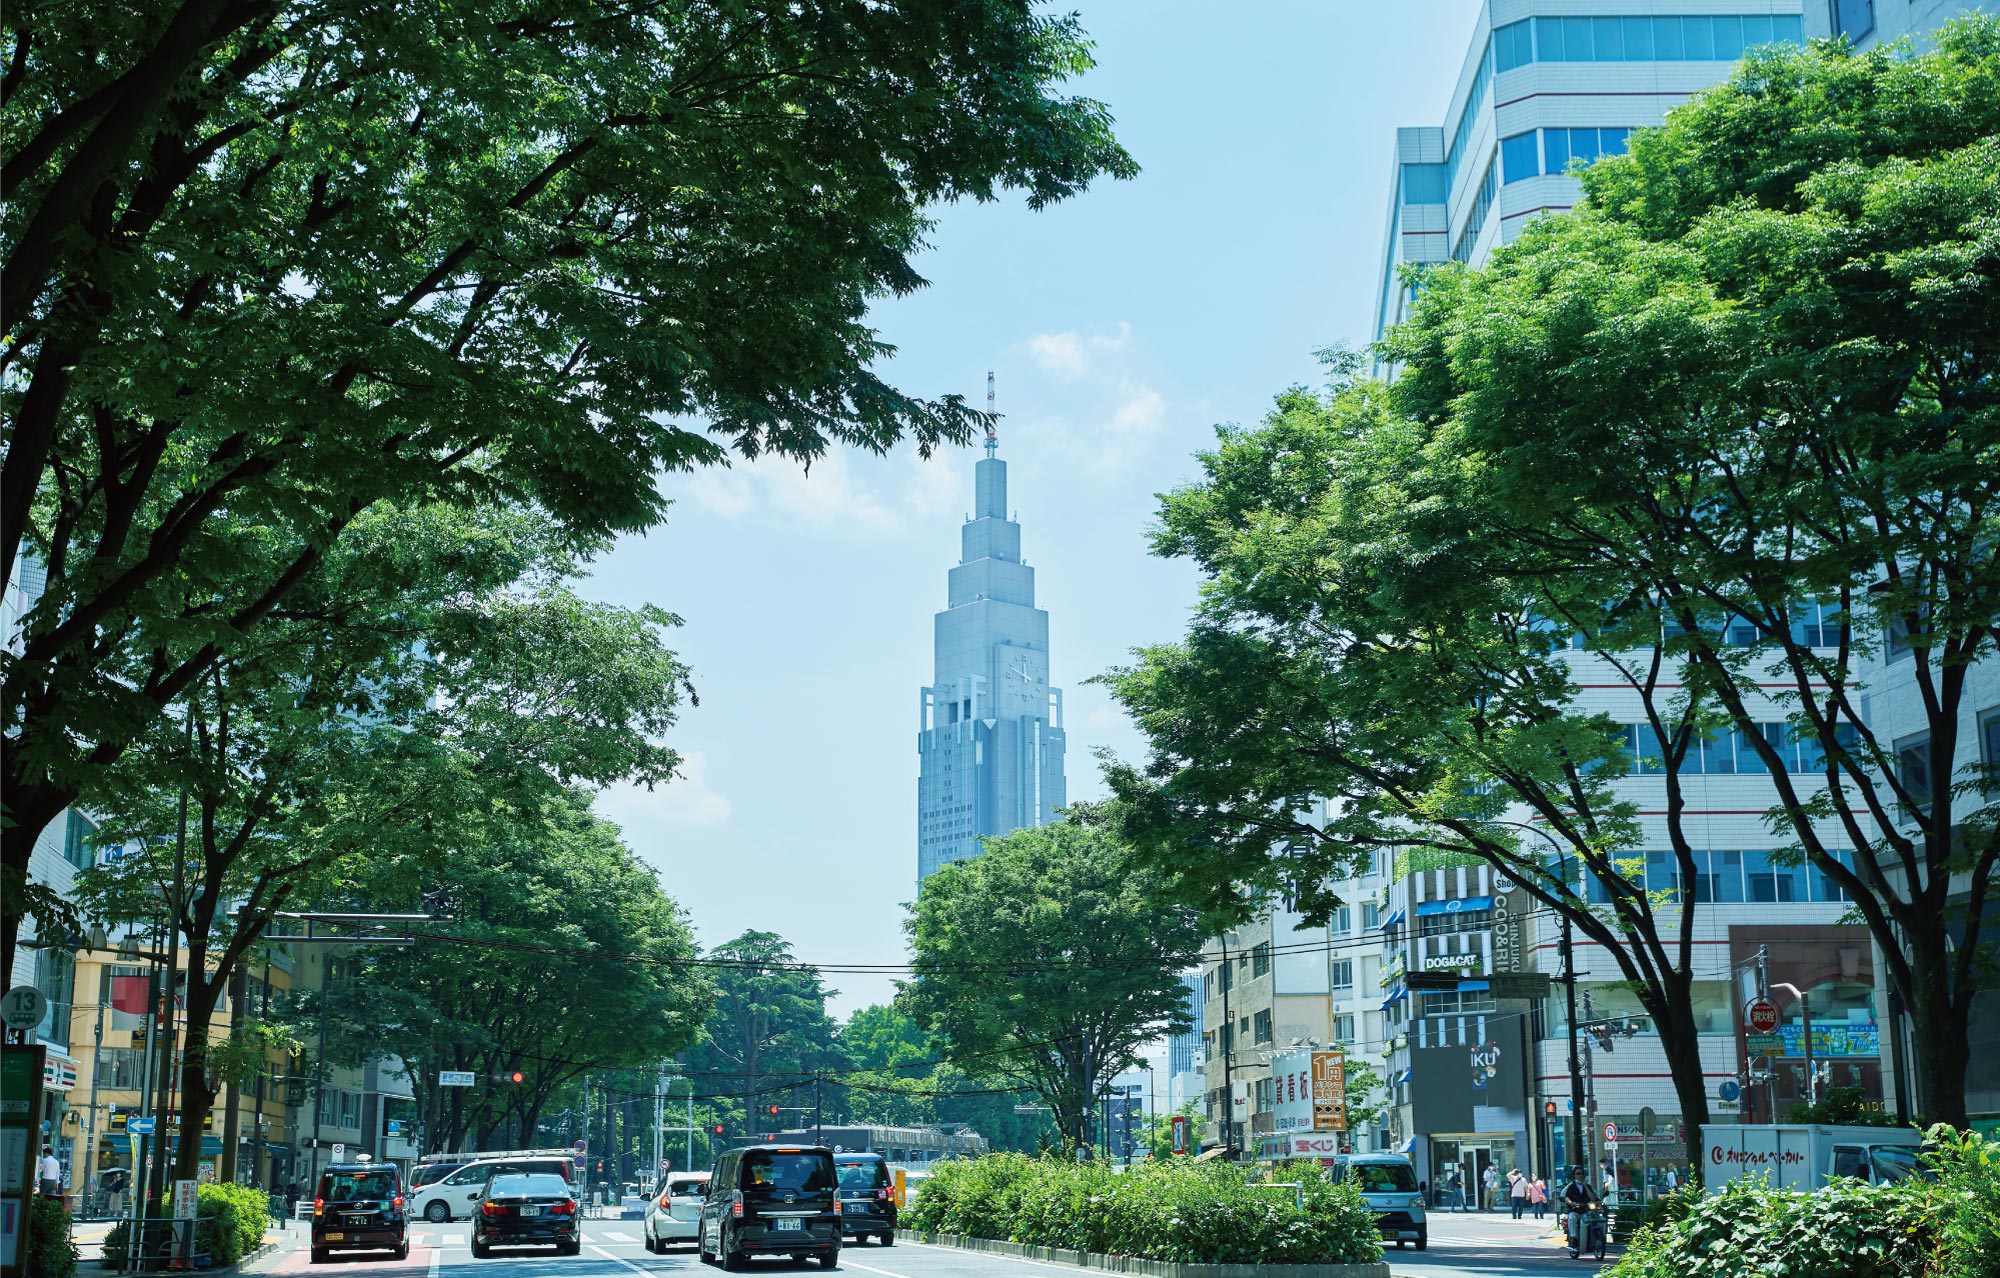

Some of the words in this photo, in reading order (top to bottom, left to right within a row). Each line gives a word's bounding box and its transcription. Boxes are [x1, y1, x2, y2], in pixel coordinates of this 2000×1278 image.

[1497, 879, 1515, 888] Shop
[1509, 912, 1520, 973] SHINJUKU
[1426, 954, 1477, 968] DOG&CAT
[13, 992, 36, 1011] 13
[1752, 1010, 1775, 1023] 消火栓
[1326, 1055, 1342, 1067] NEW
[1275, 1070, 1308, 1105] 貸看板
[1296, 1140, 1333, 1152] 宝くじ
